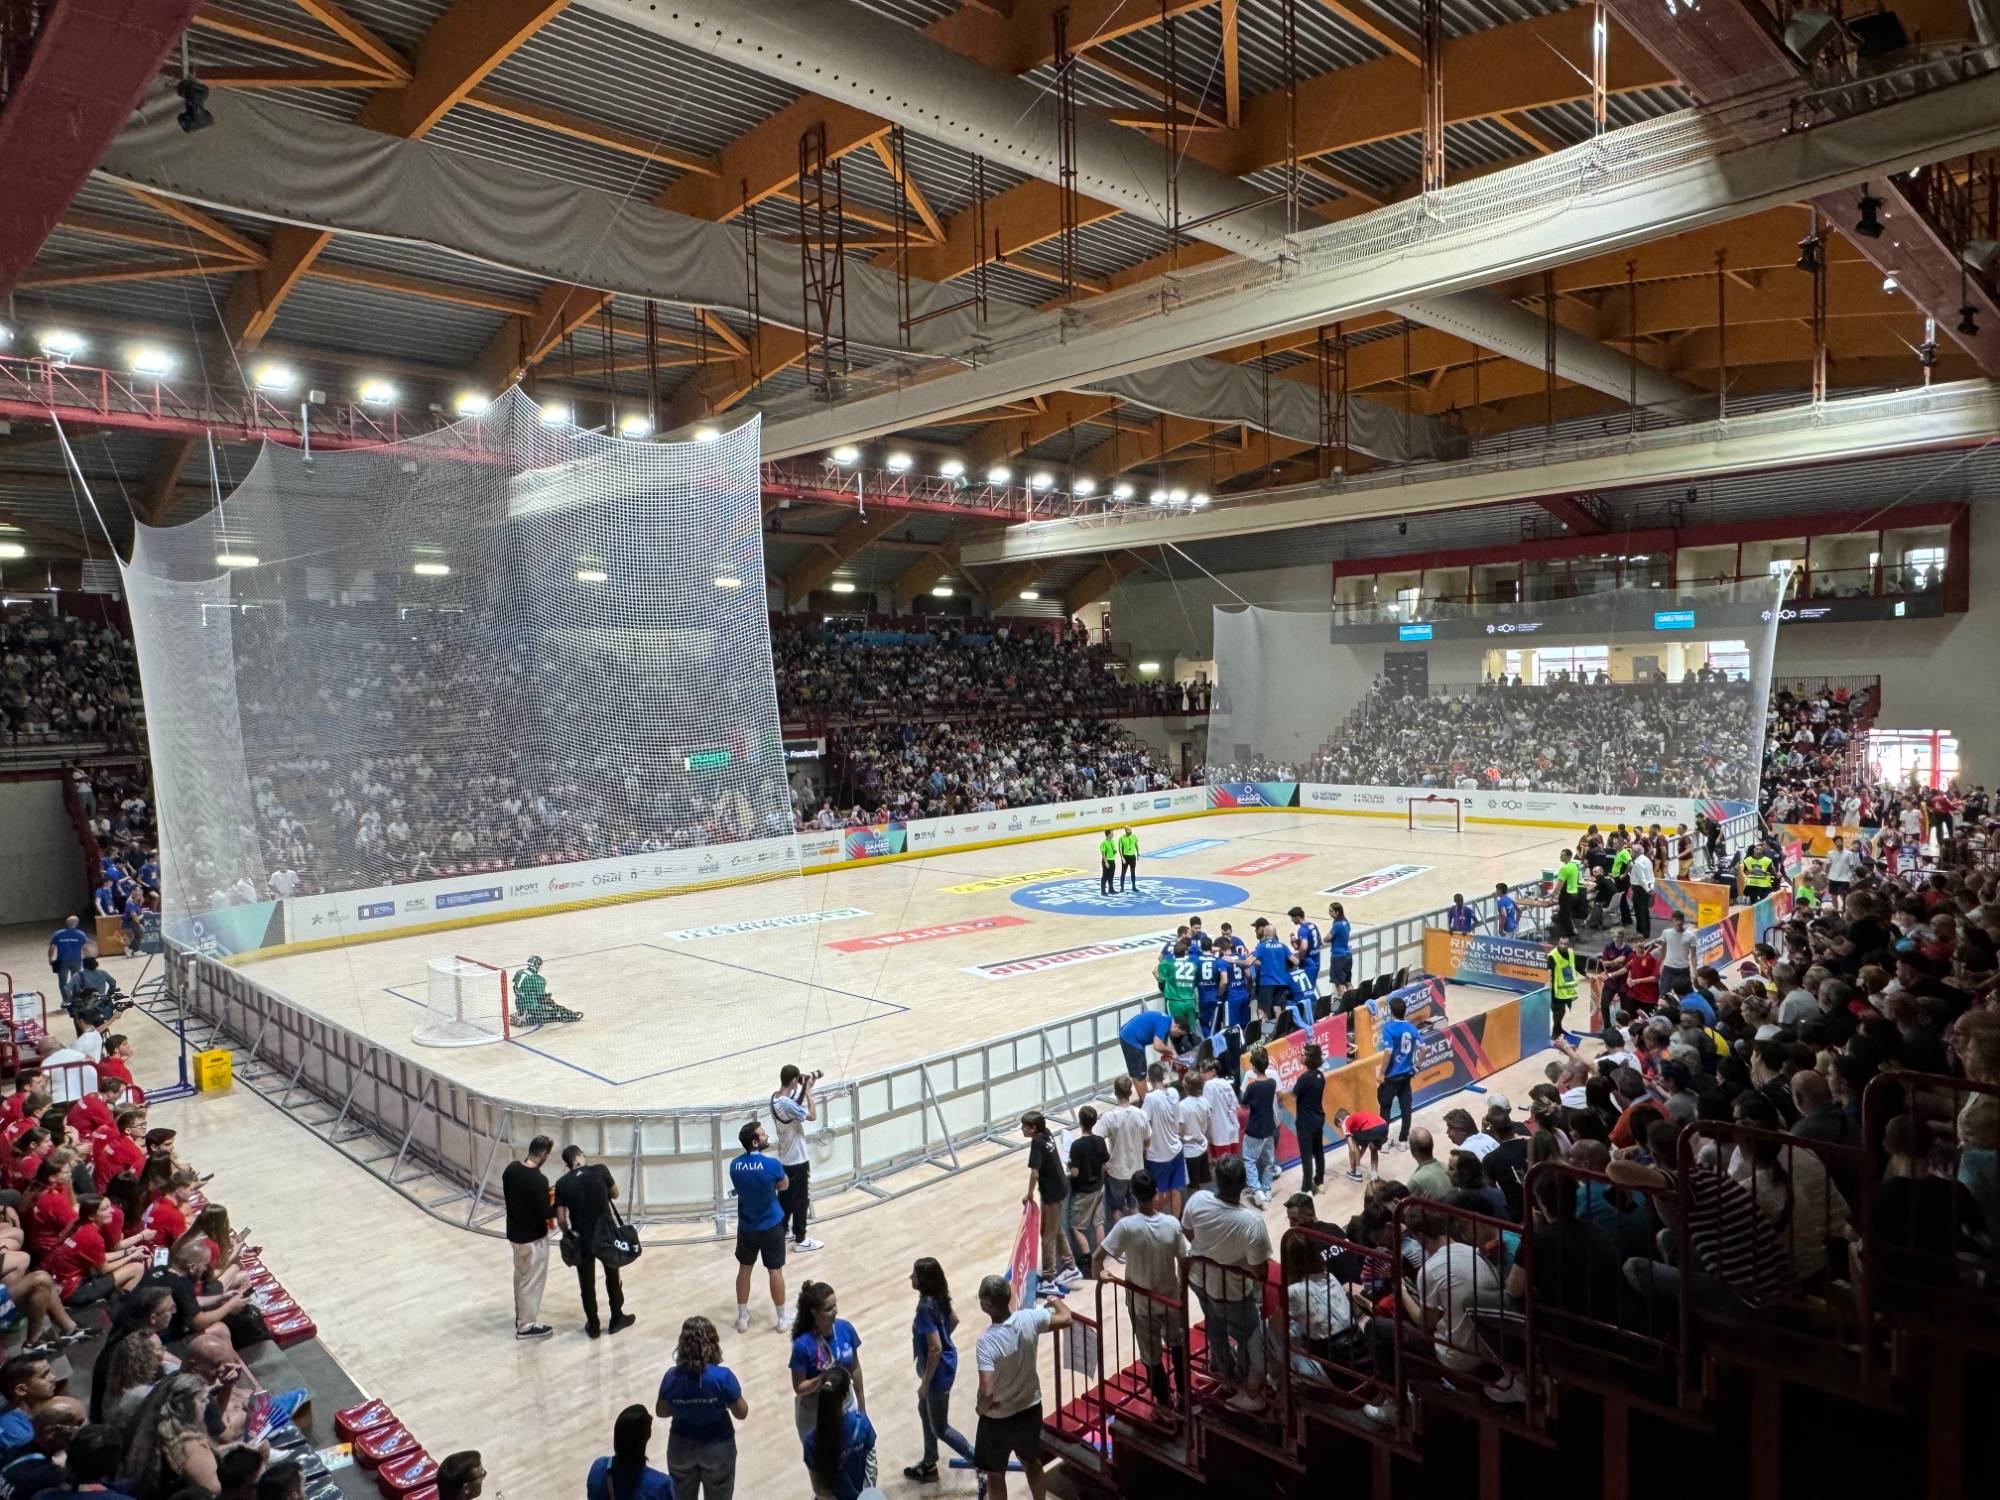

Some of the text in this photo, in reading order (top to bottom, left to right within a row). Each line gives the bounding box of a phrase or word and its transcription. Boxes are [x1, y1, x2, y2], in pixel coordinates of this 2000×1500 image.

[1450, 938, 1548, 961] RINK HOCKE
[1174, 961, 1195, 980] 22
[1201, 961, 1213, 980] 6
[1404, 986, 1433, 1006] OCKEY
[1401, 1032, 1412, 1054] 6
[735, 1161, 764, 1171] ITALIA
